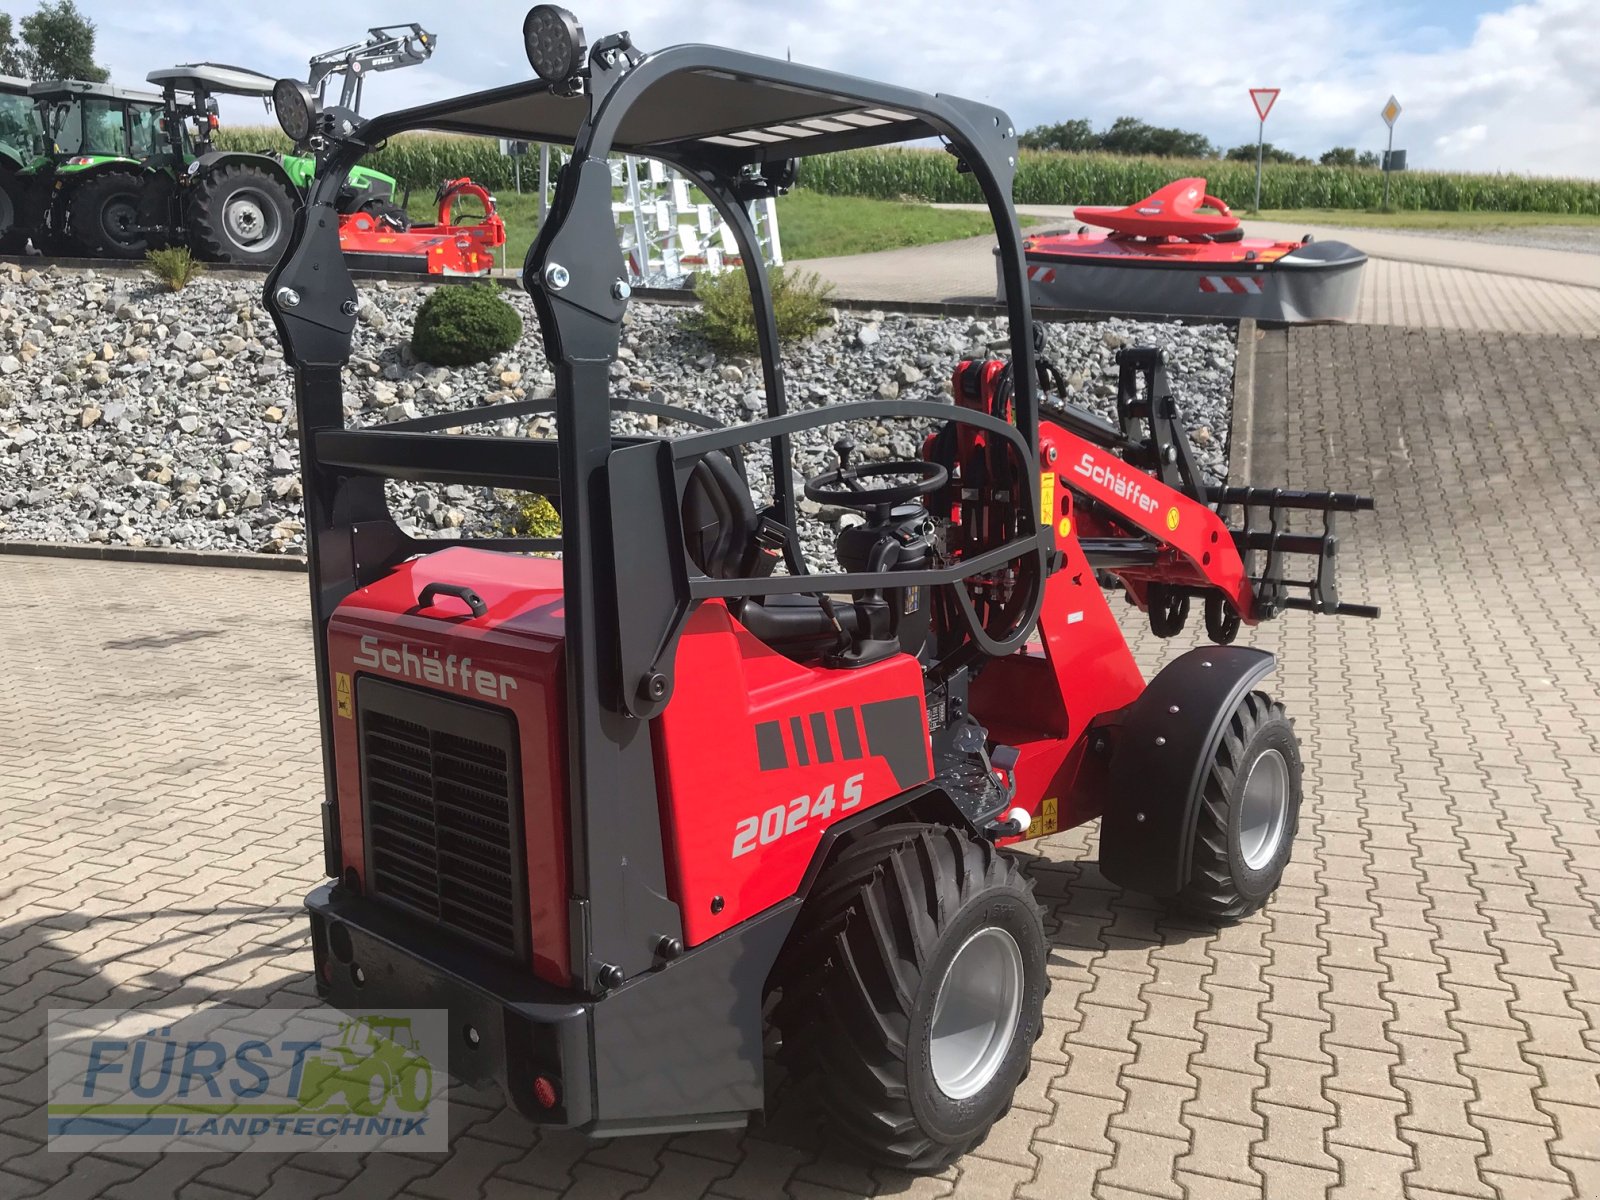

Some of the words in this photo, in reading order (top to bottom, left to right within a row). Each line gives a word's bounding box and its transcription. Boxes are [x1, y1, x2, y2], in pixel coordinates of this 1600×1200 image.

[1073, 452, 1159, 514] Schäffer
[353, 635, 519, 701] Schäffer
[732, 783, 836, 859] 2024
